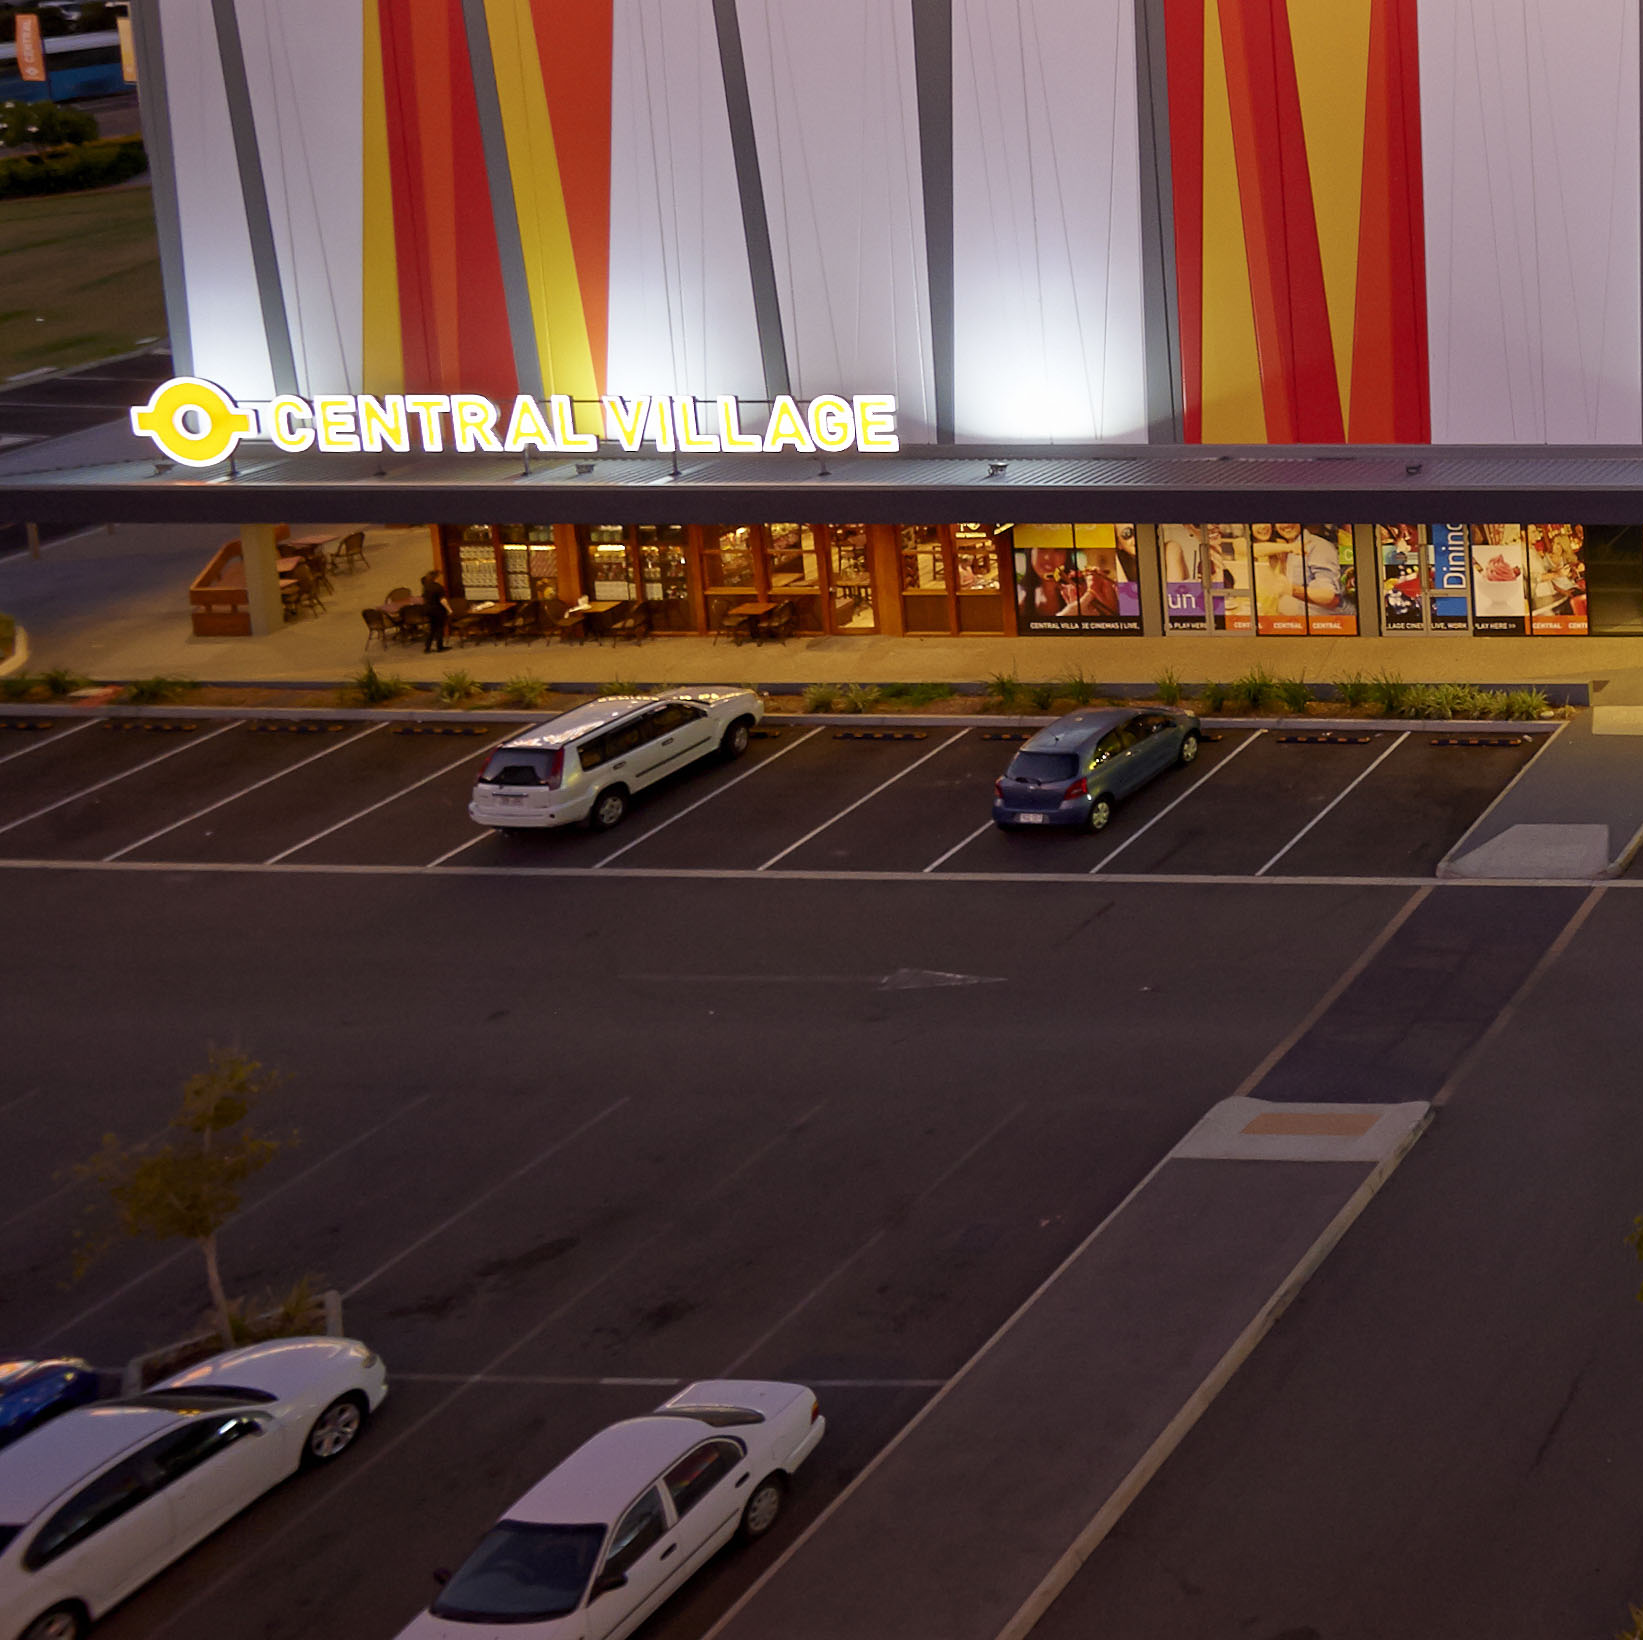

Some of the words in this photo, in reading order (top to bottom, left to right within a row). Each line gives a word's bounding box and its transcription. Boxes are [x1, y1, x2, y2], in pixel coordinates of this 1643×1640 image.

[269, 393, 599, 454] CENTRAL
[602, 393, 900, 454] VILLAGE
[1030, 622, 1060, 630] CENTRAL
[1090, 622, 1119, 630] CINEMAS
